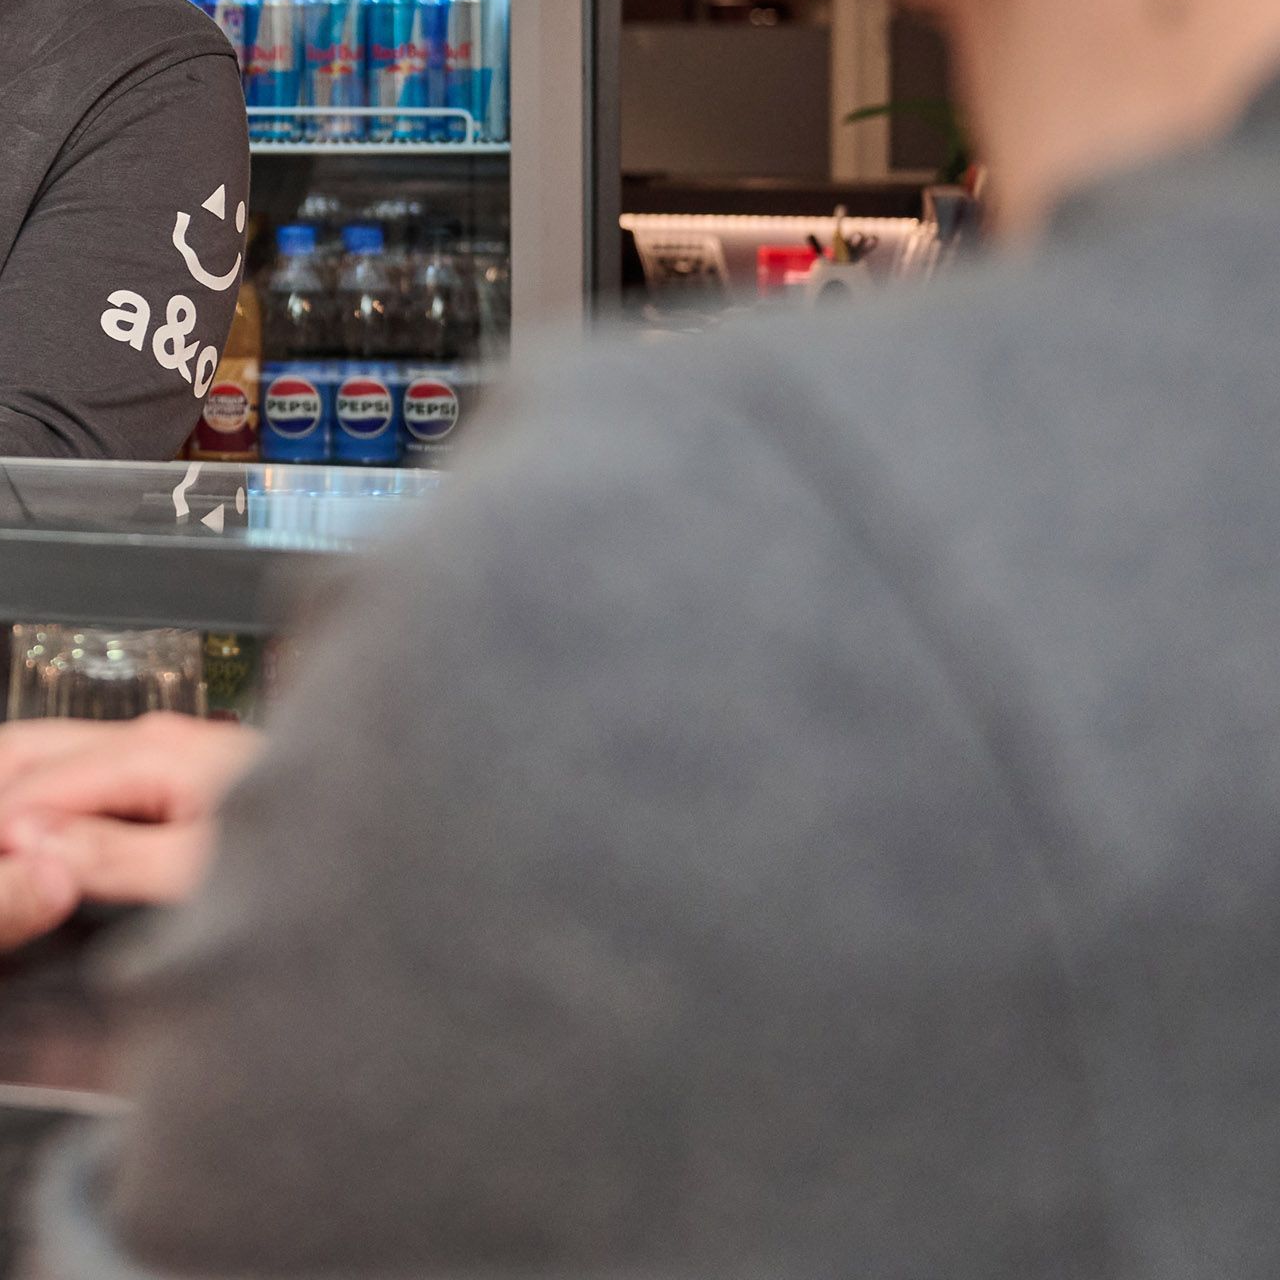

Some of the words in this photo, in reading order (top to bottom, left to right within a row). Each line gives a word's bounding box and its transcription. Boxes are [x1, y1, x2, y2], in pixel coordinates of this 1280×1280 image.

[100, 289, 218, 399] a&o
[267, 400, 318, 412] PEPSI
[338, 400, 389, 412] PEPSI
[405, 402, 456, 415] PEPSI
